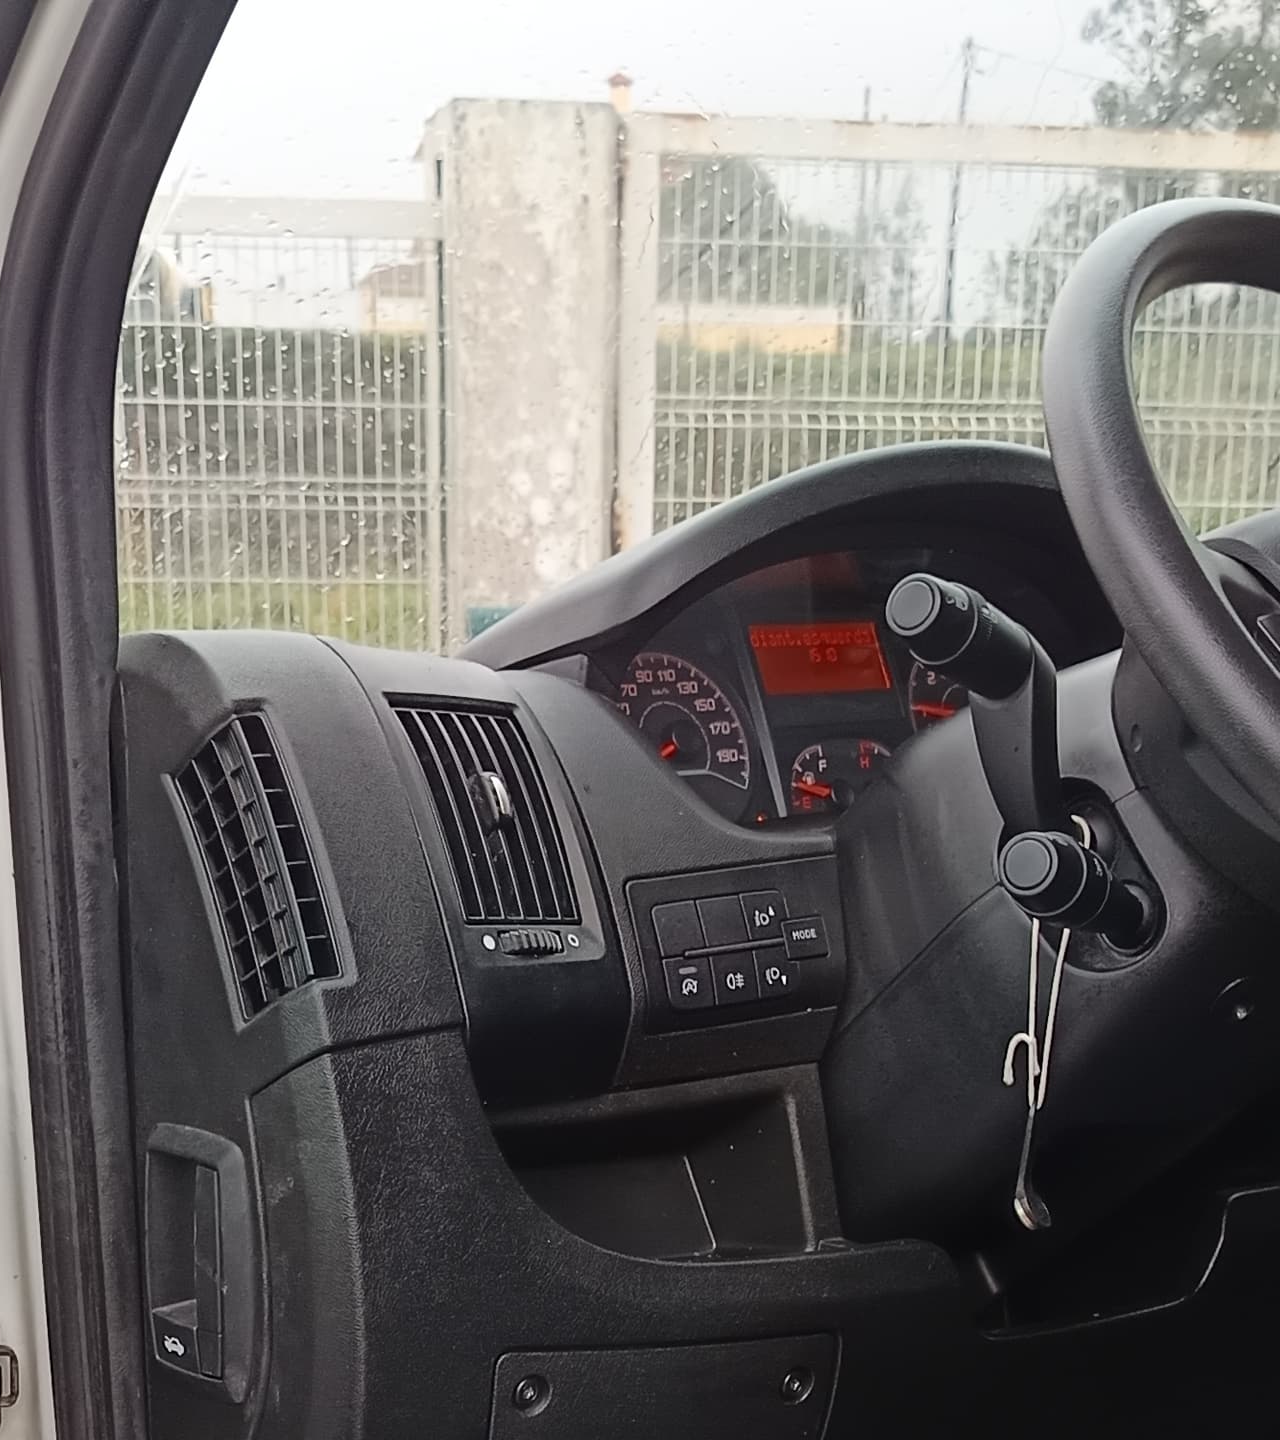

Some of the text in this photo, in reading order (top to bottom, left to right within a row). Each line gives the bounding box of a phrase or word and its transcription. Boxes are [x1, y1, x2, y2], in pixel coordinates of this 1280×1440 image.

[657, 669, 676, 683] 110
[620, 684, 638, 697] 70
[676, 681, 698, 695] 130
[694, 698, 716, 712] 150
[709, 721, 731, 735] 170
[716, 749, 738, 763] 190
[860, 756, 870, 769] H
[818, 759, 827, 773] F
[802, 796, 812, 809] E
[792, 928, 817, 941] MODE
